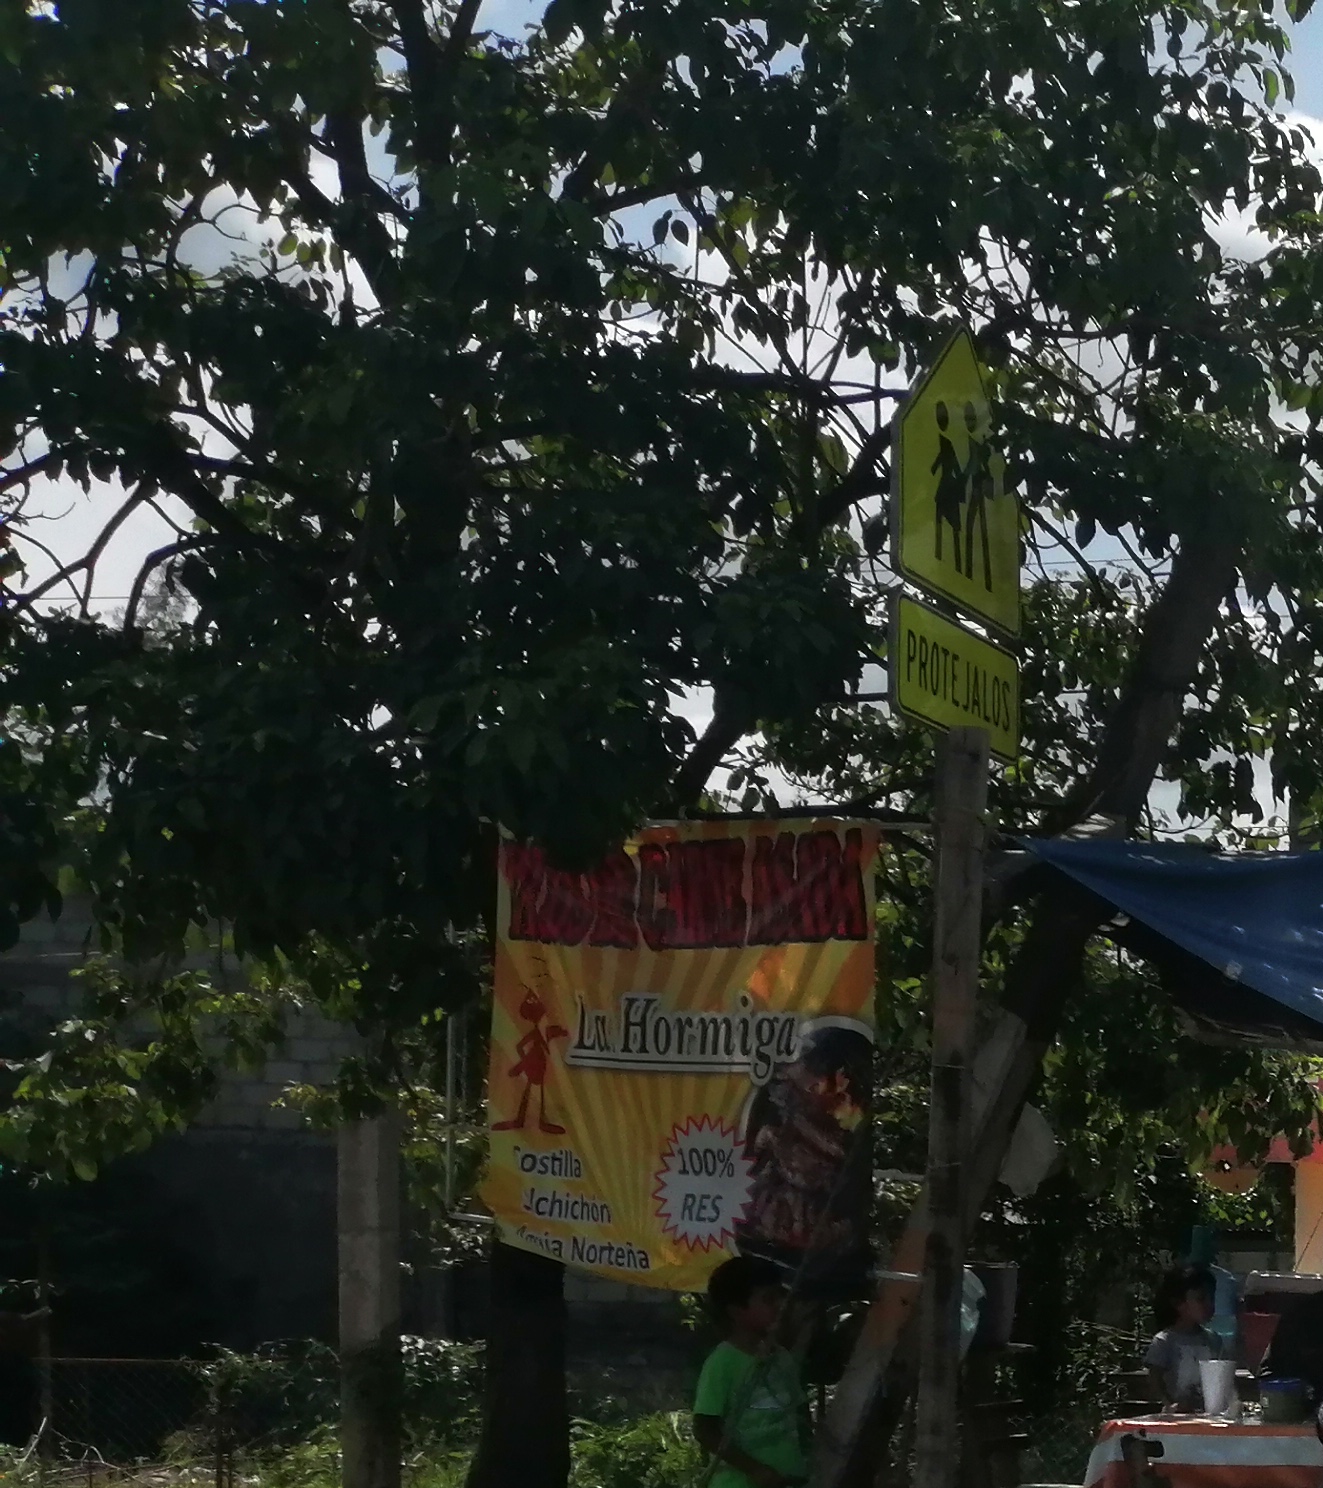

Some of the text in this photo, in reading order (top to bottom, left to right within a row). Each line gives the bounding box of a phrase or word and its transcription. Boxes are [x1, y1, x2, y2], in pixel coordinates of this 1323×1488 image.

[906, 629, 1011, 732] PROTEJALOS
[573, 994, 797, 1080] La Hormiga
[513, 1145, 582, 1178] ostilla
[677, 1147, 735, 1178] 100%
[680, 1193, 723, 1223] RES
[571, 1235, 650, 1270] Norteña
